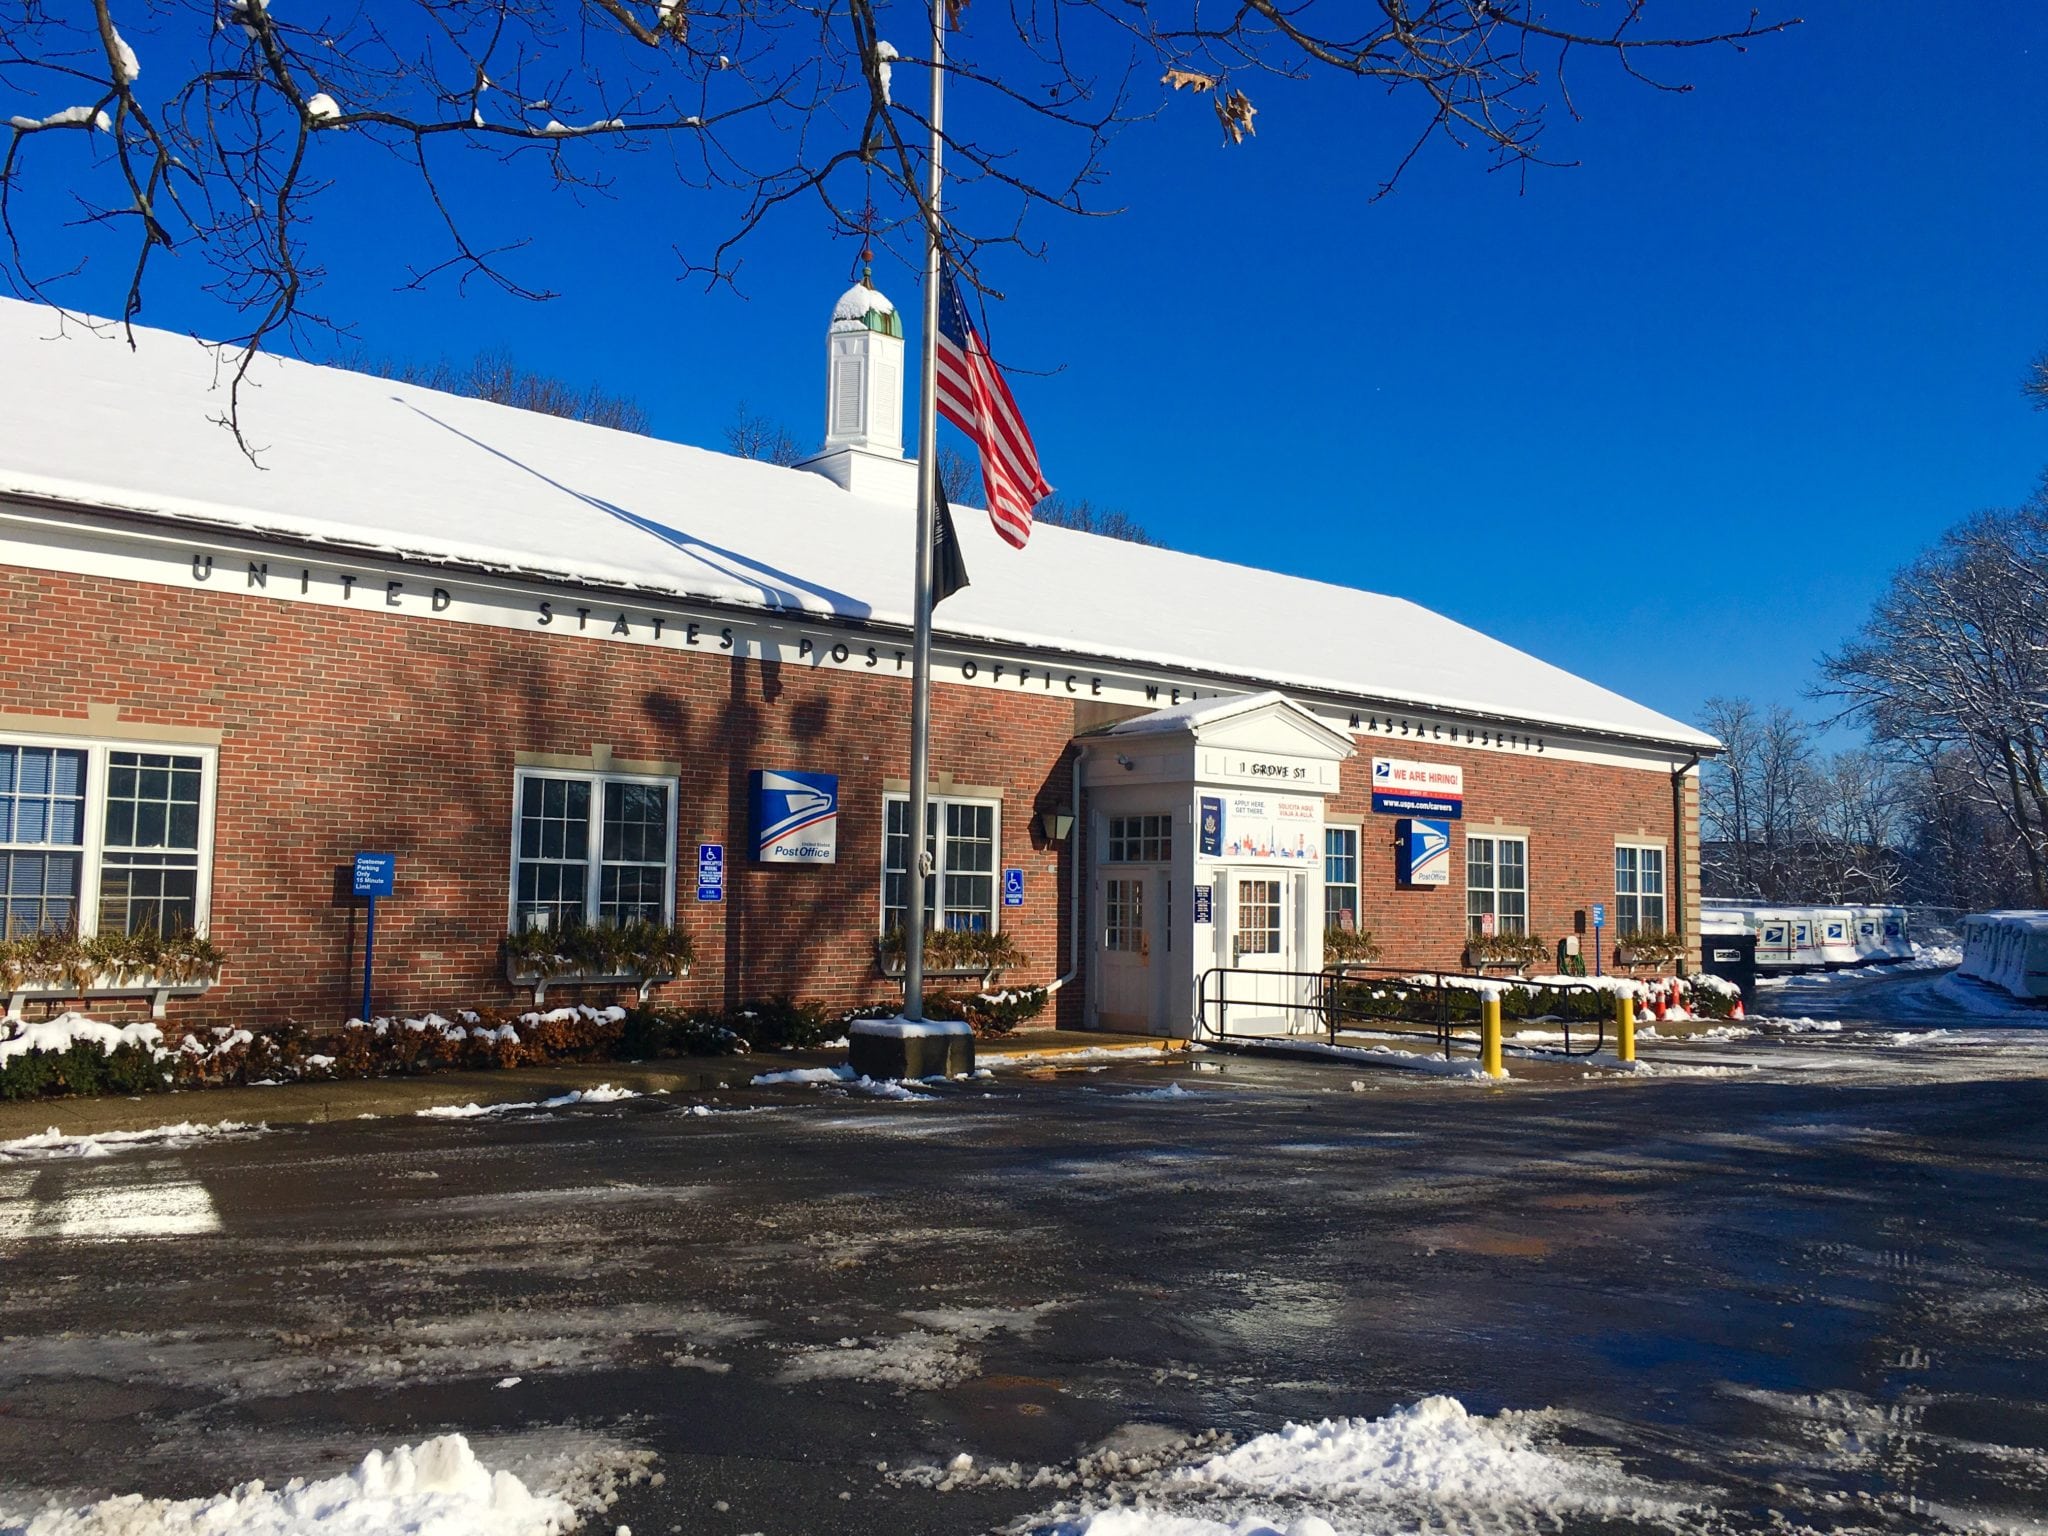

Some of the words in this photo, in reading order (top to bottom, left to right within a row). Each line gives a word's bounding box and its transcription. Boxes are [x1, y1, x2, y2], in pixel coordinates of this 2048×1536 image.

[193, 555, 451, 612] UNITED
[537, 602, 734, 649] STATES
[800, 639, 906, 671] POST
[962, 661, 1102, 696] OFFICE
[1349, 713, 1545, 753] MASSACHUSETTS
[1251, 764, 1289, 777] GROVE
[1293, 767, 1306, 778] ST
[1393, 768, 1407, 780] WE
[1409, 771, 1427, 782] ARE
[1429, 773, 1458, 785] HIRING!
[1383, 799, 1453, 812] www.usps.com/careers
[775, 846, 799, 856] Post
[800, 847, 830, 858] Office
[1418, 872, 1431, 880] Post
[1431, 873, 1446, 881] Office
